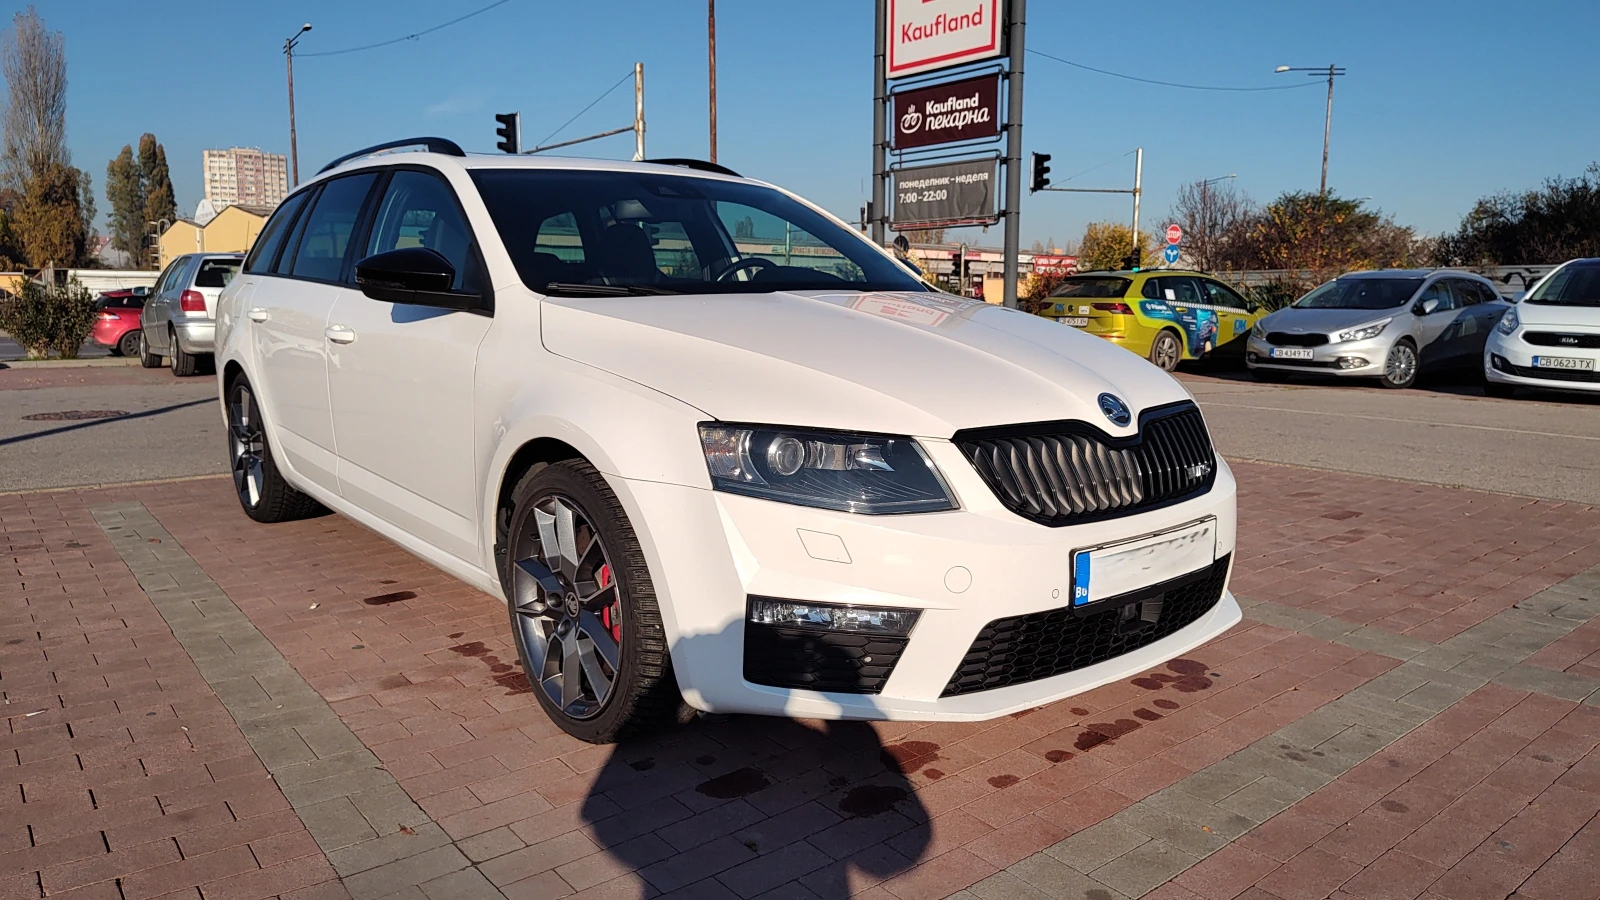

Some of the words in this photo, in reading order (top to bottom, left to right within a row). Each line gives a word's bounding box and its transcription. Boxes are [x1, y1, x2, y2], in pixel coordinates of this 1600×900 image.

[901, 3, 983, 44] Kaufland
[925, 92, 979, 115] Kaufland
[925, 107, 990, 131] пекарна
[1167, 231, 1180, 239] STOP
[1275, 349, 1283, 357] CB
[1284, 349, 1301, 358] 4349
[1302, 350, 1311, 358] TK
[1539, 358, 1552, 367] CB
[1553, 359, 1577, 369] 0623
[1579, 360, 1592, 369] TX
